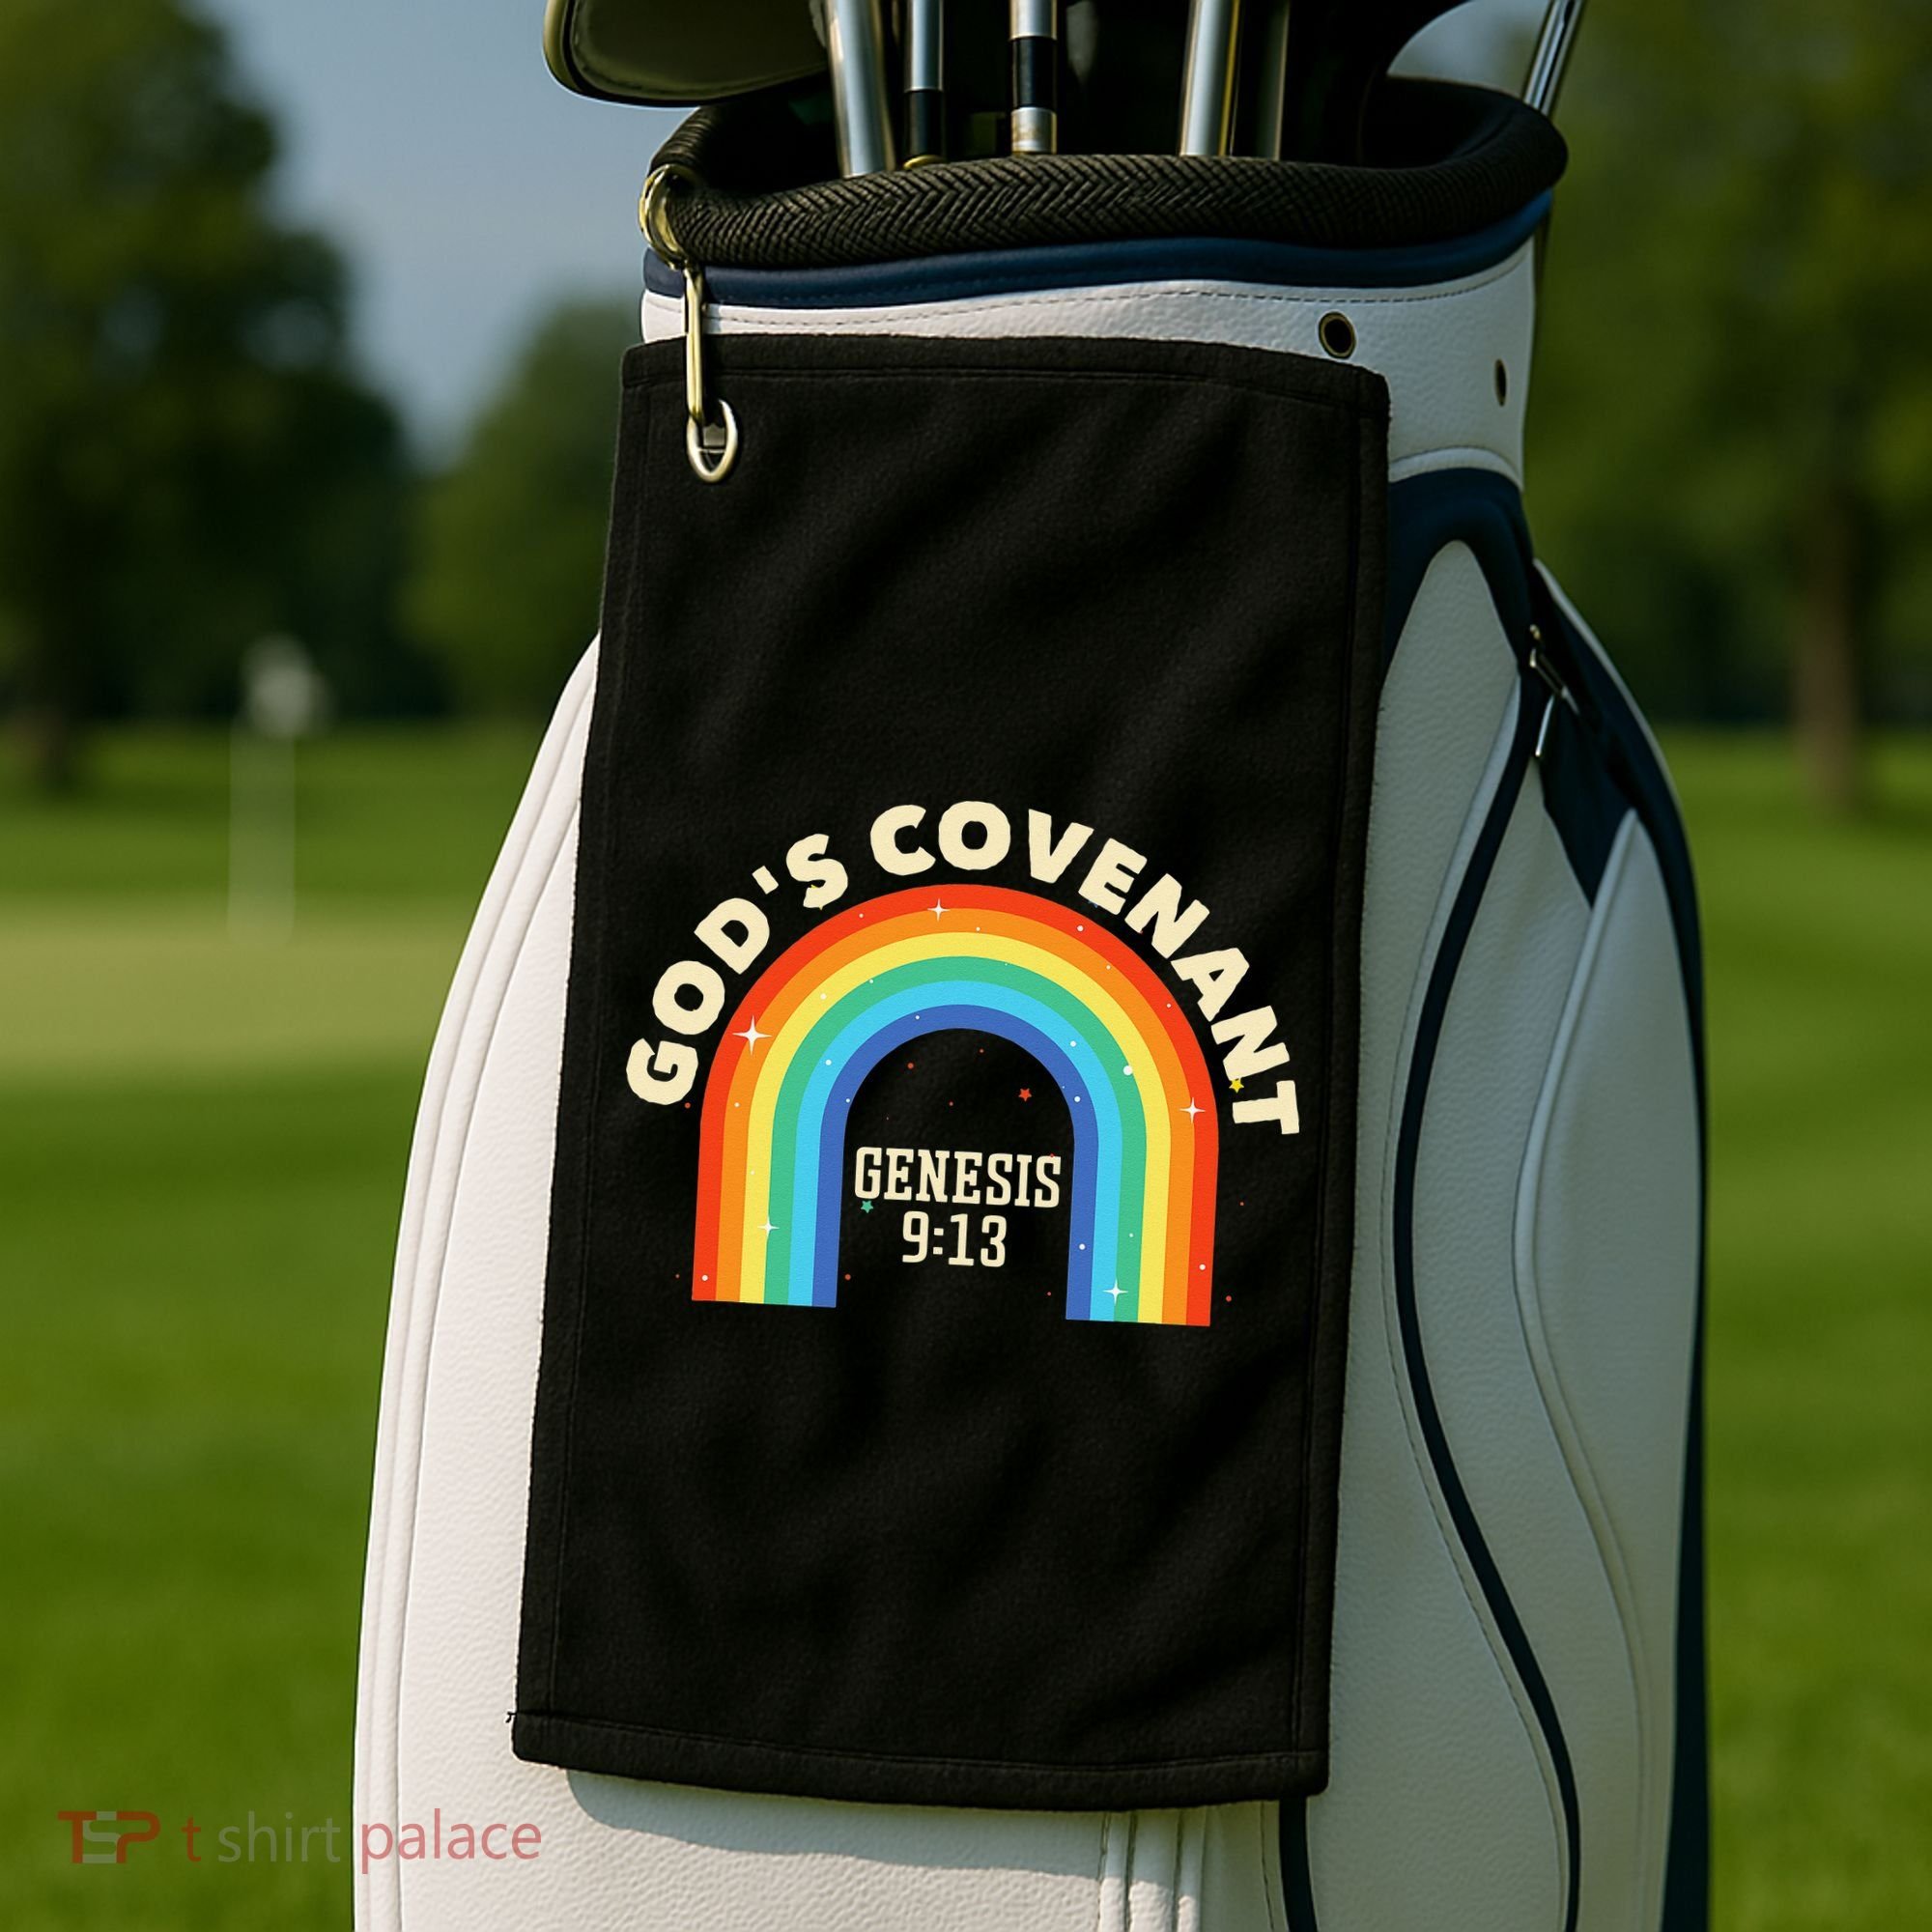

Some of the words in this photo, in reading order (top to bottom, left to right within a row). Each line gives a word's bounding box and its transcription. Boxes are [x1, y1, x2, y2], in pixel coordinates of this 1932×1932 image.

[625, 833, 849, 1106] GOD'S
[869, 800, 1300, 1135] COVENANT
[854, 1146, 1062, 1208] GENESIS
[902, 1210, 1007, 1267] 9:13
